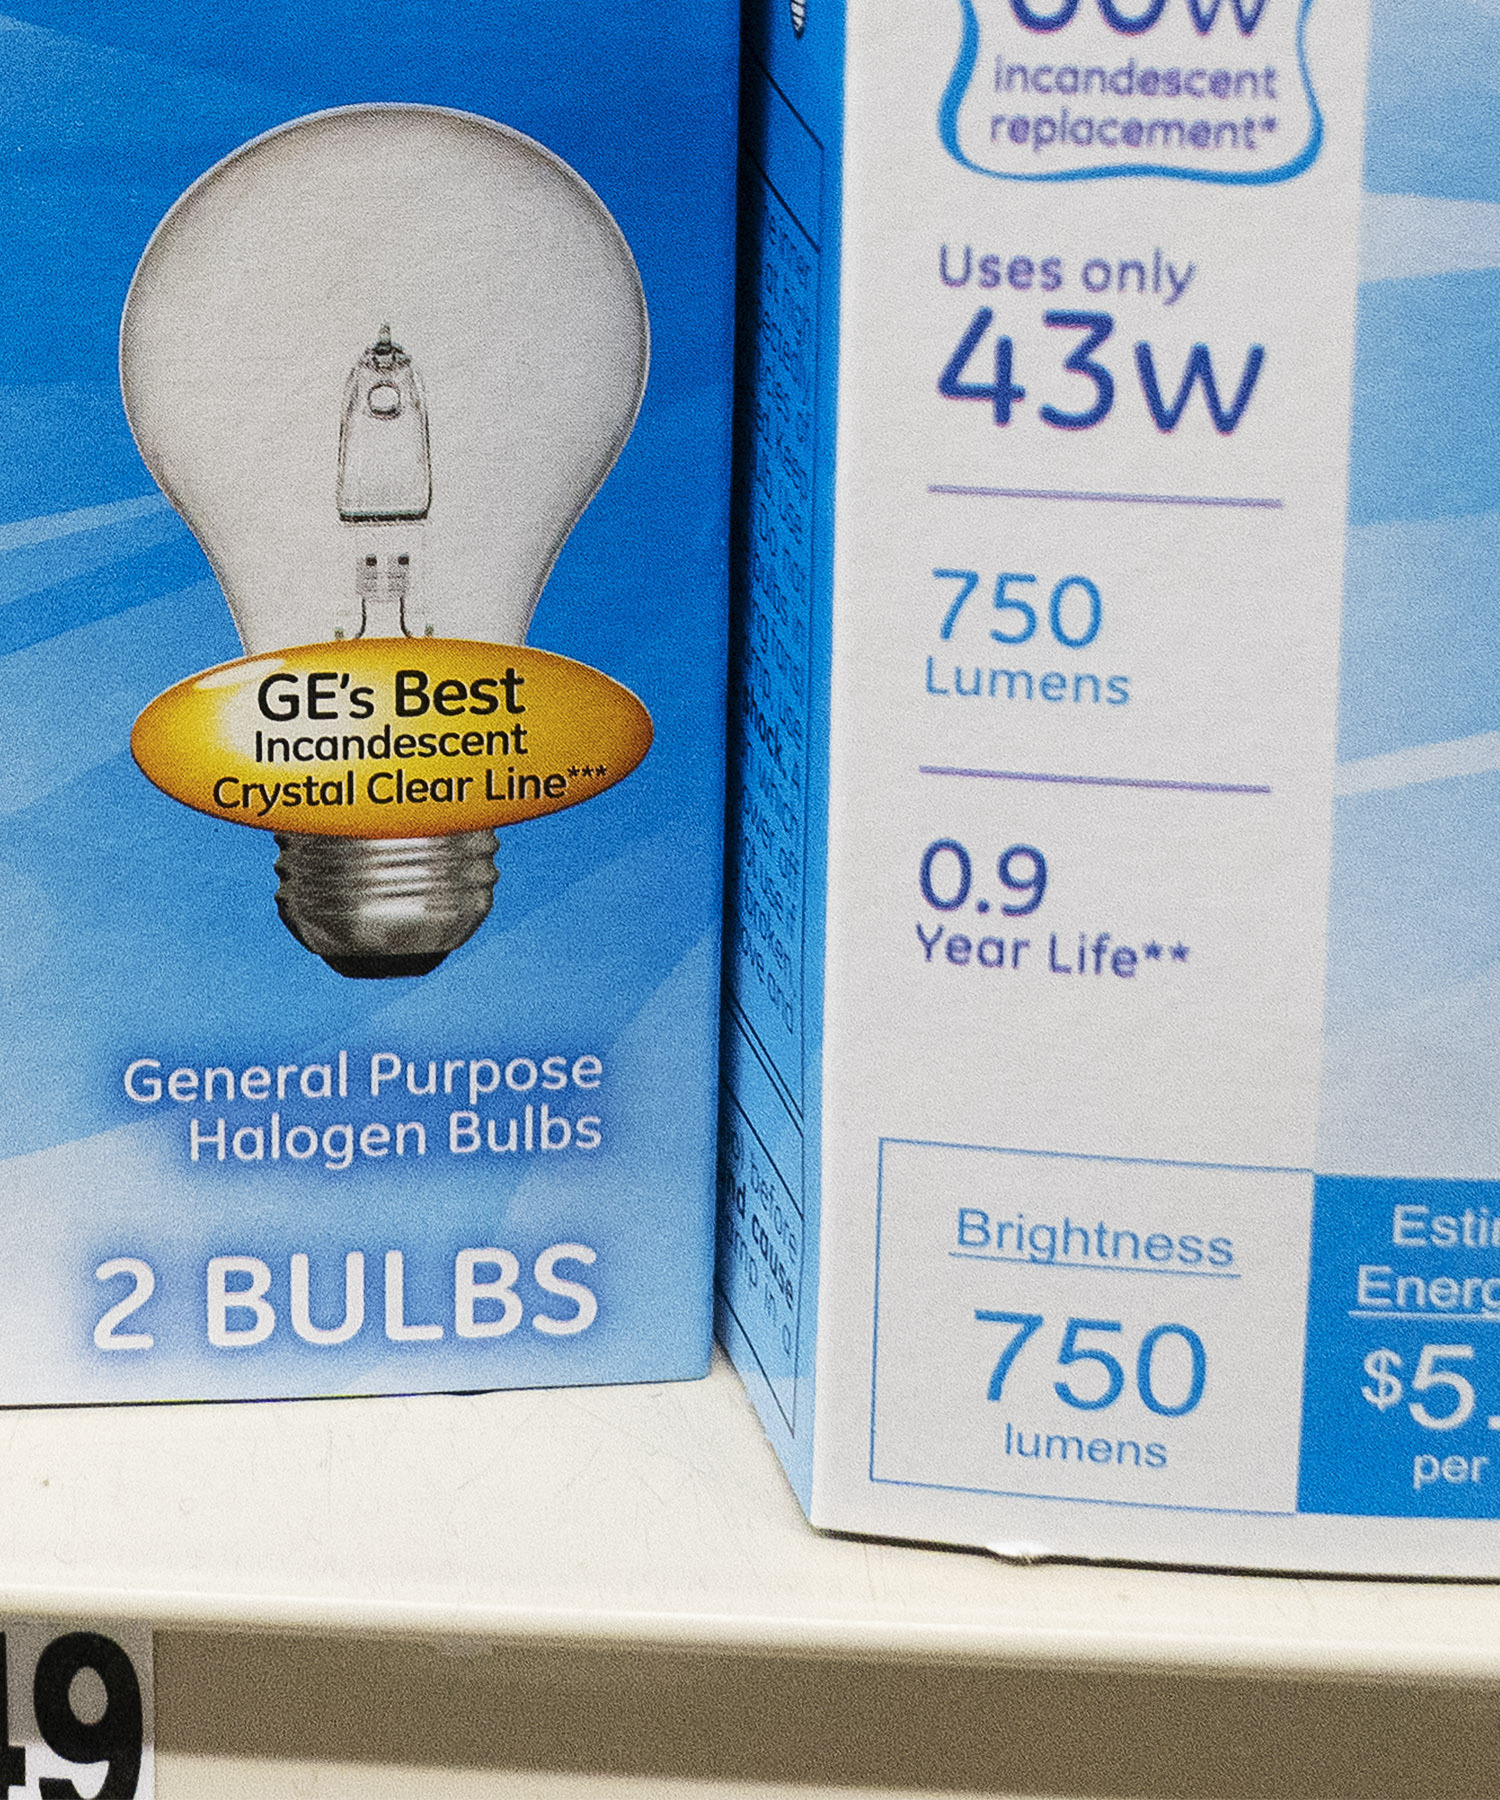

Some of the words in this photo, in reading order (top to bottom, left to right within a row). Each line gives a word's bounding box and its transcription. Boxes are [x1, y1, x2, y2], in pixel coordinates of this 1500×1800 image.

[995, 58, 1277, 101] incandescent
[938, 245, 1061, 293] Uses
[1081, 250, 1195, 305] only
[937, 307, 1265, 435] 43w
[931, 569, 1102, 649] 750
[257, 672, 374, 721] GE's
[396, 668, 525, 717] Best
[925, 656, 1130, 706] Lumens
[255, 724, 527, 764] Incandescent
[213, 770, 356, 817] Crystal
[367, 770, 472, 806] Clear
[919, 838, 1049, 917] 0.9
[916, 924, 1030, 970] Year
[124, 1051, 348, 1102] General
[371, 1051, 603, 1105] Purpose
[190, 1108, 427, 1170] Halogen
[450, 1104, 602, 1153] Bulbs
[956, 1209, 1234, 1268] Brightness
[93, 1258, 155, 1351] 2
[206, 1243, 599, 1348] BULBS
[973, 1310, 1206, 1418] 750
[1004, 1423, 1168, 1468] lumens
[1412, 1449, 1488, 1492] per
